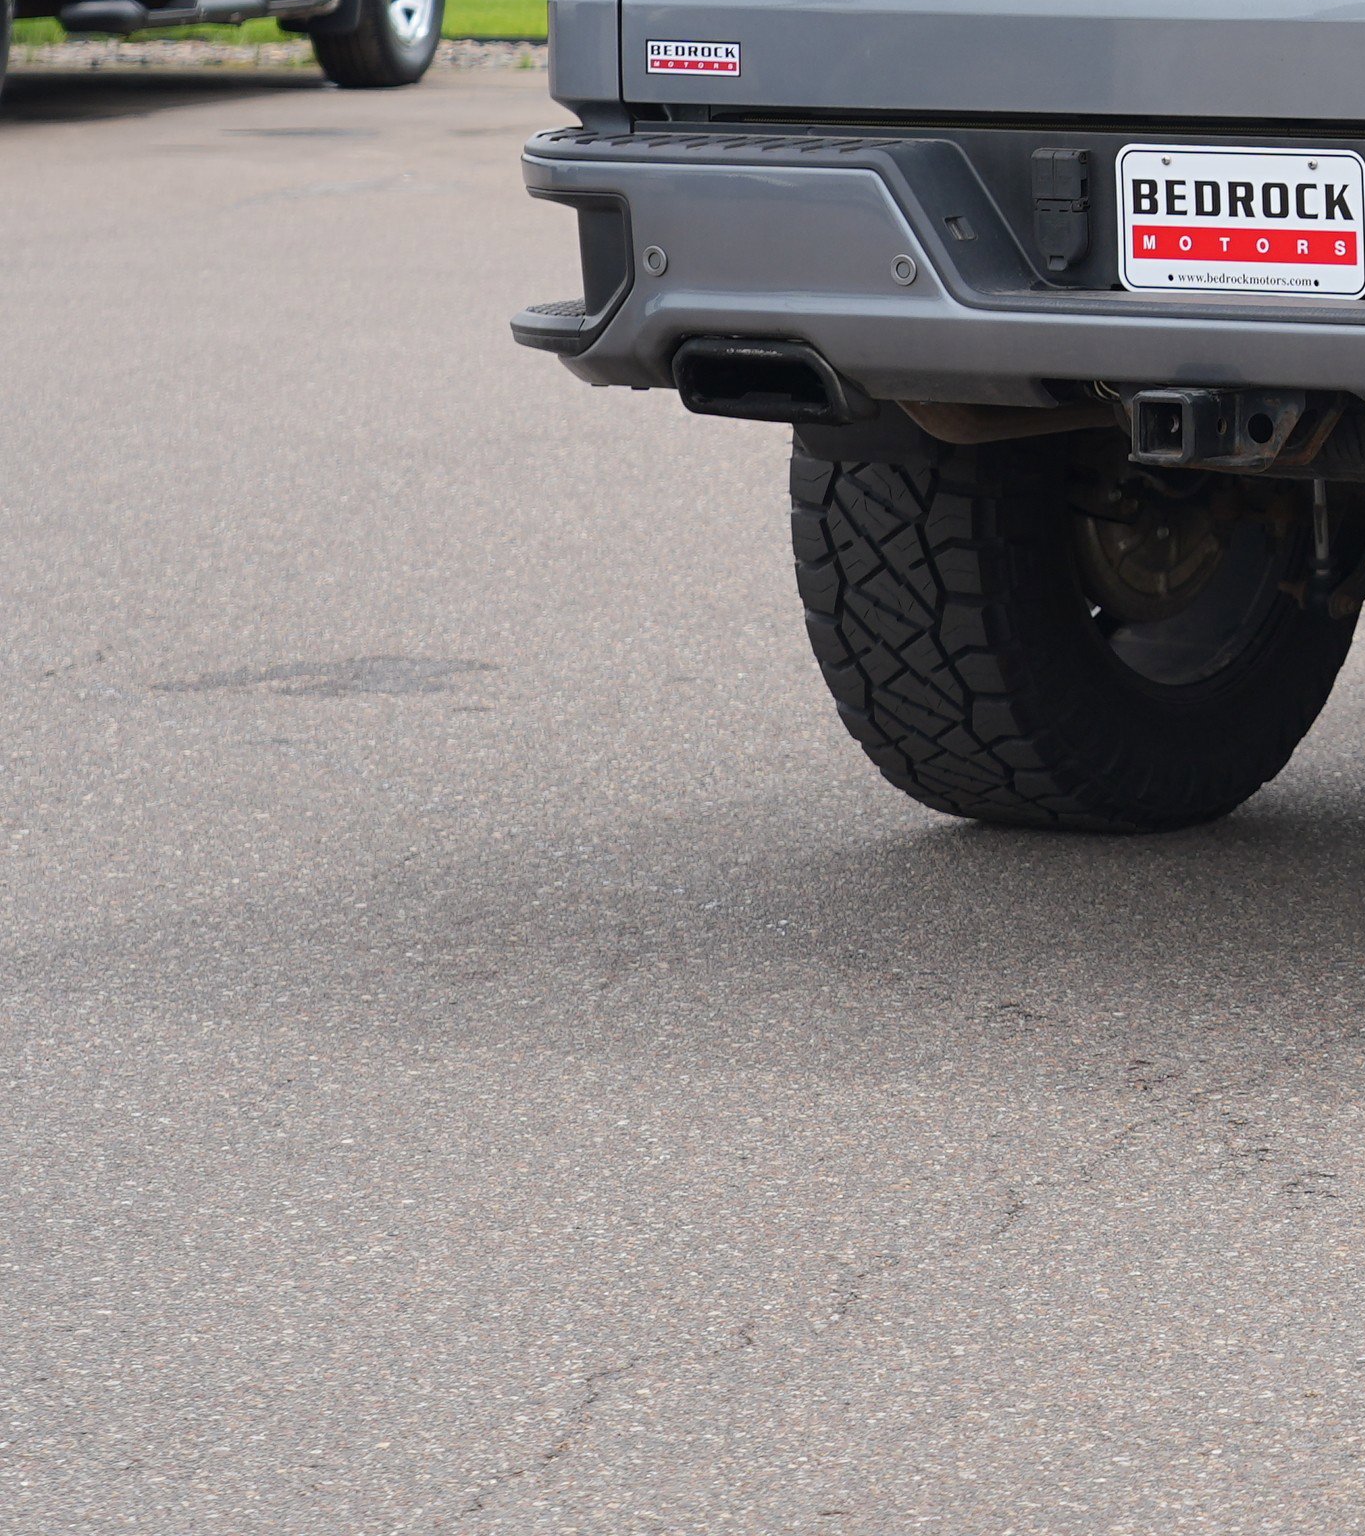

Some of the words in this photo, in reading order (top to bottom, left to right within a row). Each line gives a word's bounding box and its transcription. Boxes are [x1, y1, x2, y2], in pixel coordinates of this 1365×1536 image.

[650, 45, 736, 59] BEDROCK
[653, 61, 734, 70] MOTORS
[1132, 179, 1355, 221] BEDROCK
[1143, 234, 1347, 257] MOTORS
[1178, 272, 1313, 288] www.bedrockmotors.com
